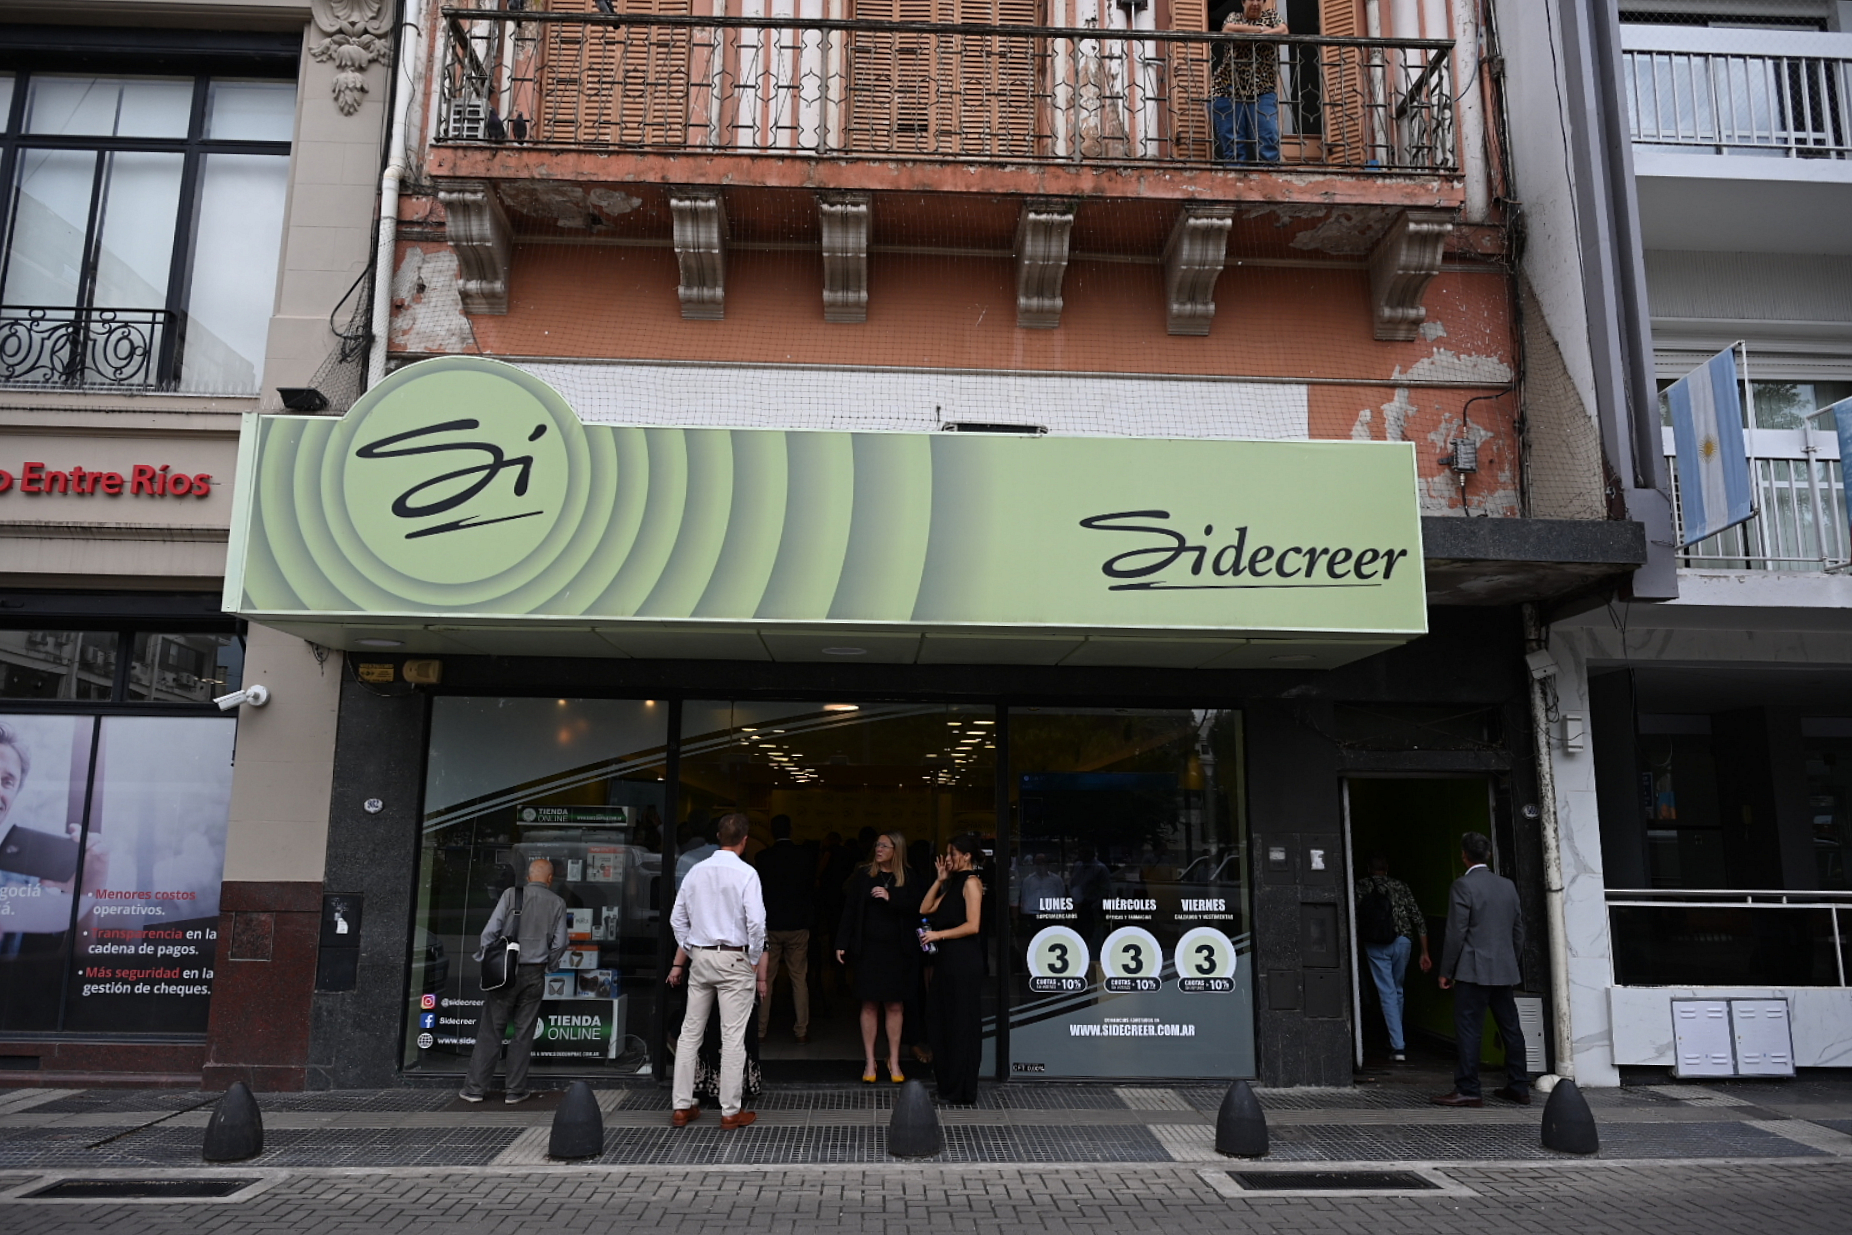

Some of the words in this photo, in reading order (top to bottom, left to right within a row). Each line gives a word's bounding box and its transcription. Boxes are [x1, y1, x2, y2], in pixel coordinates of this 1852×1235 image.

[20, 461, 124, 495] Entre
[130, 464, 212, 497] Ríos
[1079, 510, 1408, 582] Sidecreer
[537, 814, 569, 823] ONLINE
[95, 889, 152, 900] Menores
[154, 889, 196, 901] costos
[93, 903, 165, 917] operativos.
[1039, 897, 1074, 911] LUNES
[1102, 897, 1157, 912] MIÉRCOLES
[1180, 898, 1226, 912] VIERNES
[91, 927, 183, 941] Transparencia
[186, 930, 202, 940] en
[205, 928, 218, 940] la
[88, 943, 136, 954] cadena
[138, 943, 155, 954] de
[157, 945, 199, 958] pagos.
[1047, 943, 1069, 974] 3
[1121, 944, 1144, 975] 3
[1194, 944, 1217, 976] 3
[85, 966, 112, 978] Más
[115, 967, 180, 981] seguridad
[182, 970, 199, 979] en
[202, 968, 214, 979] la
[82, 981, 131, 996] gestión
[134, 982, 151, 994] de
[153, 982, 211, 997] cheques.
[441, 998, 485, 1008] @sidecreer
[439, 1016, 477, 1025] Sidecreer
[548, 1015, 601, 1026] TIENDA
[548, 1026, 601, 1040] ONLINE
[1069, 1024, 1195, 1037] WWW.SIDECREER.COM.AR
